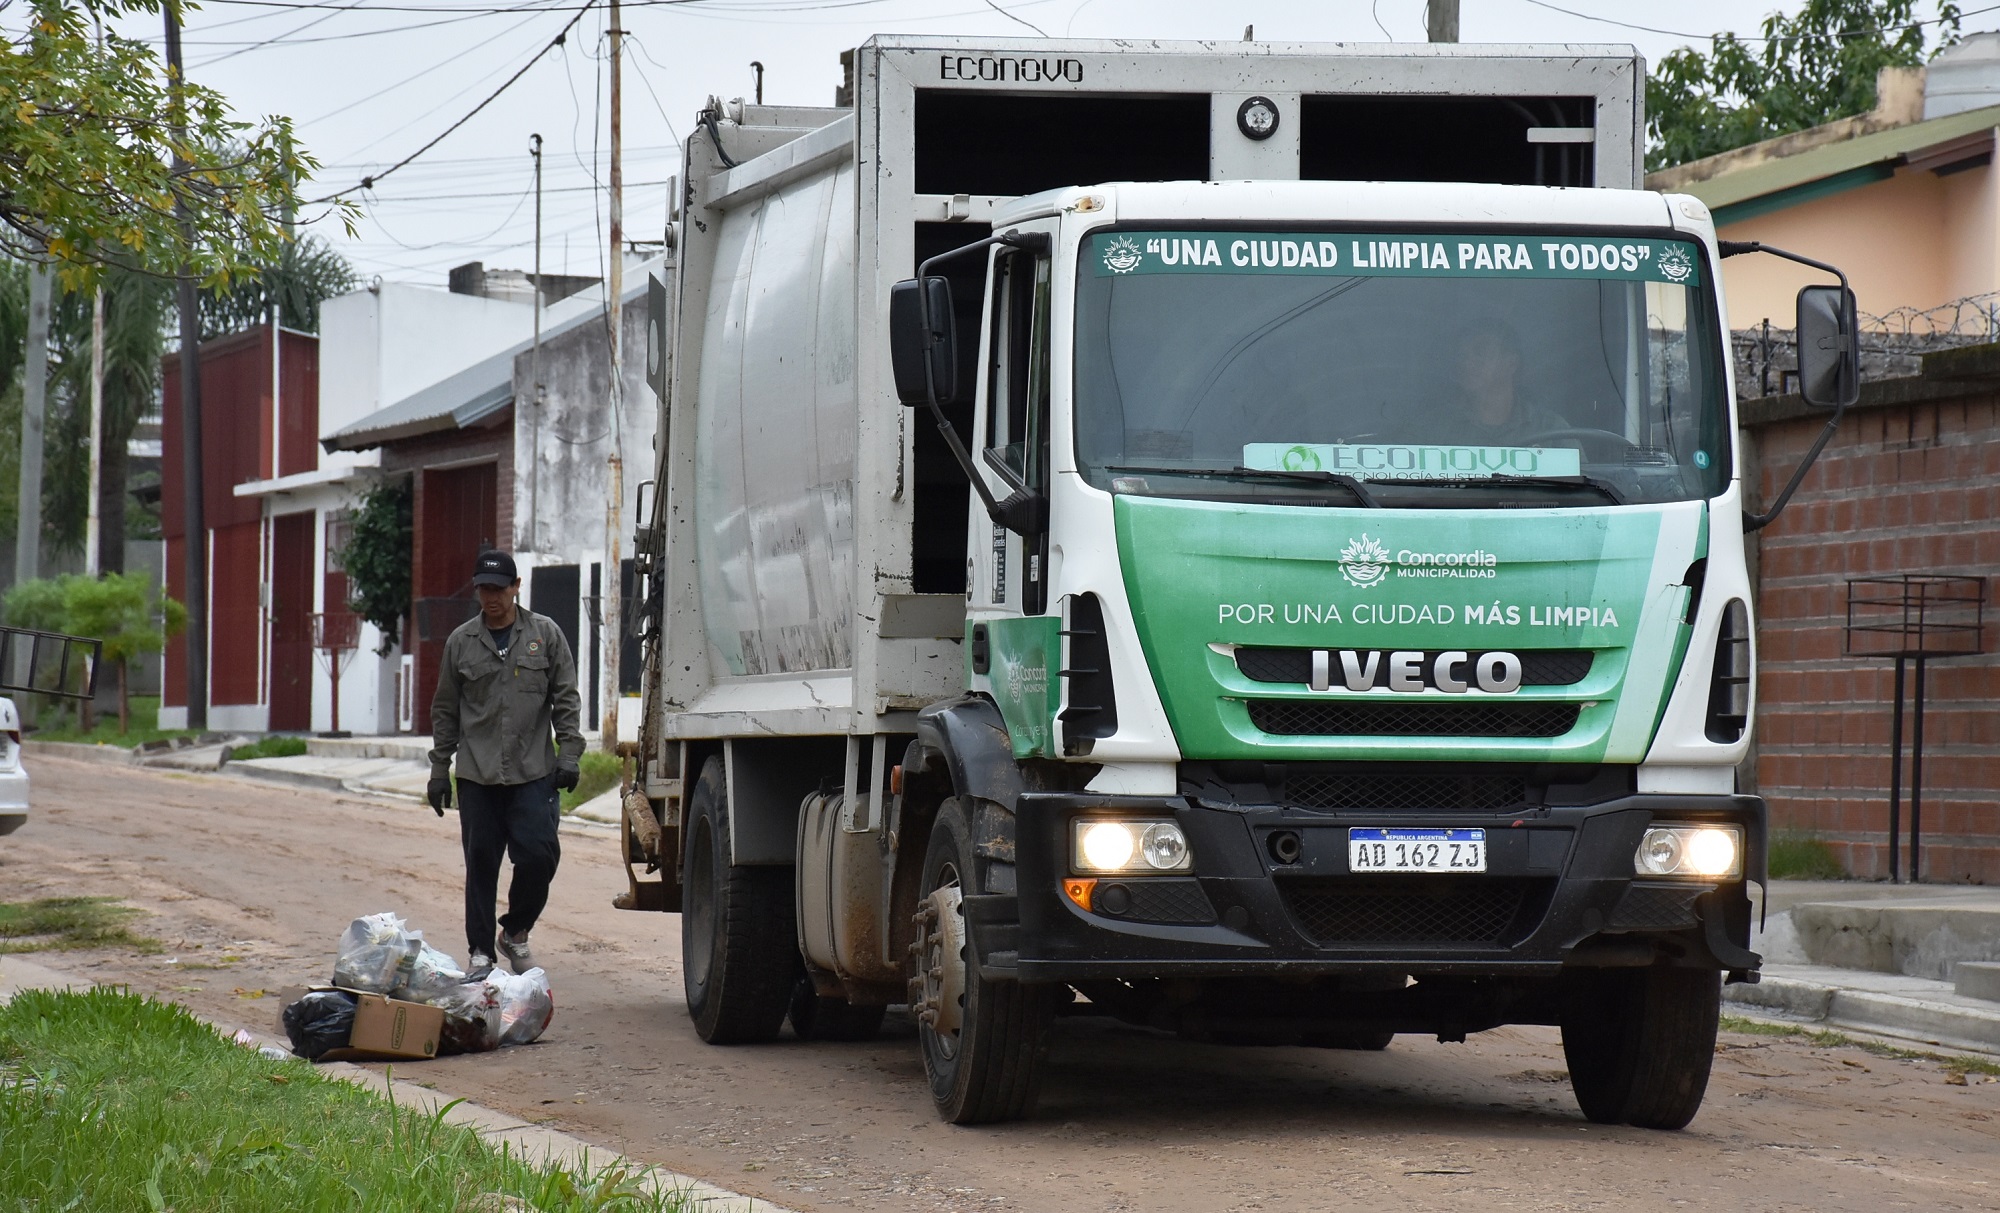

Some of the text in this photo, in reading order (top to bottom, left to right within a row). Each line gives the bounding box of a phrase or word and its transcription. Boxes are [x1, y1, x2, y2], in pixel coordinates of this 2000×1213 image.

[1146, 238, 1650, 272] “UNA CIUDAD LIMPIA PARA TODOS”
[1397, 549, 1497, 567] Concordia
[1397, 568, 1496, 578] MUNICIPALIDAD
[1218, 600, 1619, 628] POR UNA CIUDAD MÁS LIMPIA
[1311, 650, 1523, 692] IVECO
[1357, 843, 1479, 867] AD 162 ZJ
